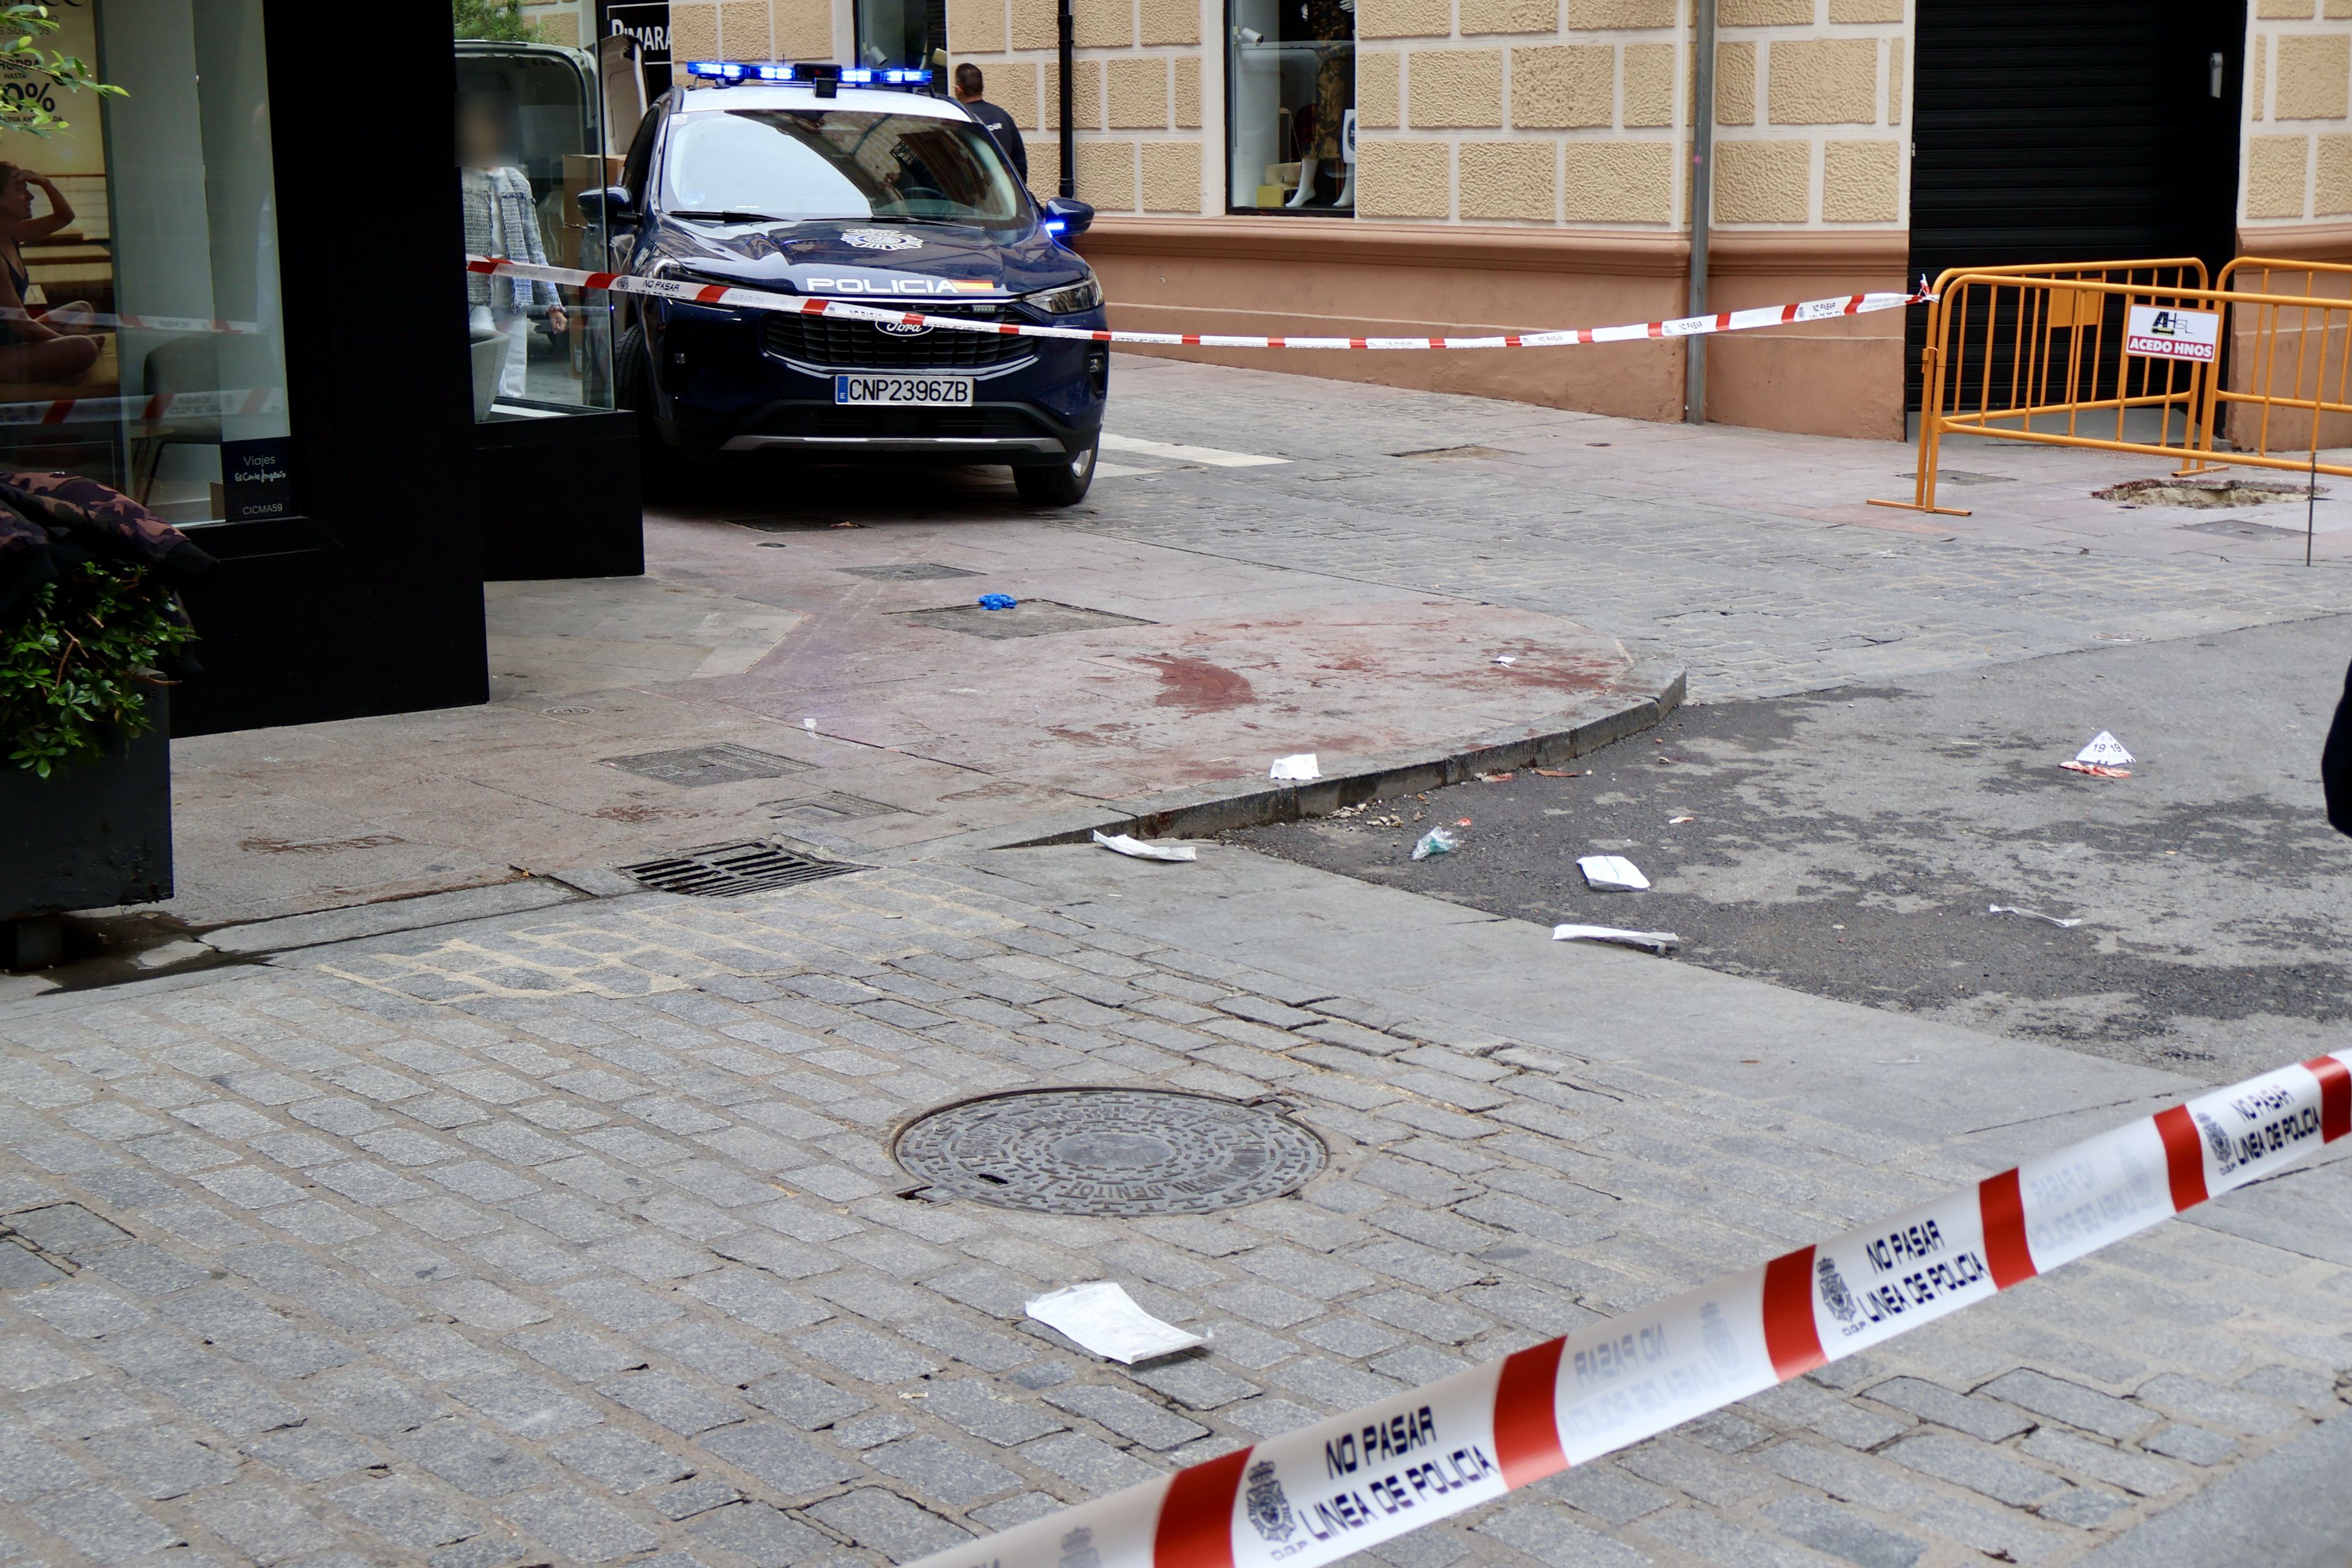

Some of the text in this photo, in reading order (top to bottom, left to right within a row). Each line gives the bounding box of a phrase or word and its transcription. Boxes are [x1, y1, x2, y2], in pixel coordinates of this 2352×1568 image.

[643, 280, 680, 292] NO PASAR
[807, 278, 959, 293] POLICIA
[2130, 338, 2212, 357] ACEDO HNOS
[850, 379, 968, 402] CNP2396ZB
[243, 455, 276, 467] Viajes
[243, 503, 283, 514] CICMA59
[2094, 743, 2106, 753] 19
[2110, 743, 2122, 753] 19
[2229, 1085, 2294, 1123] NO PASAR
[2232, 1106, 2323, 1165] LINEA DE POLICIA
[1866, 1219, 1945, 1275] NO PASAR
[1856, 1251, 1990, 1322] LINEA DE POLICIA
[1325, 1405, 1437, 1480] NO PASAR
[1298, 1445, 1498, 1540] LINEA DE POLICIA
